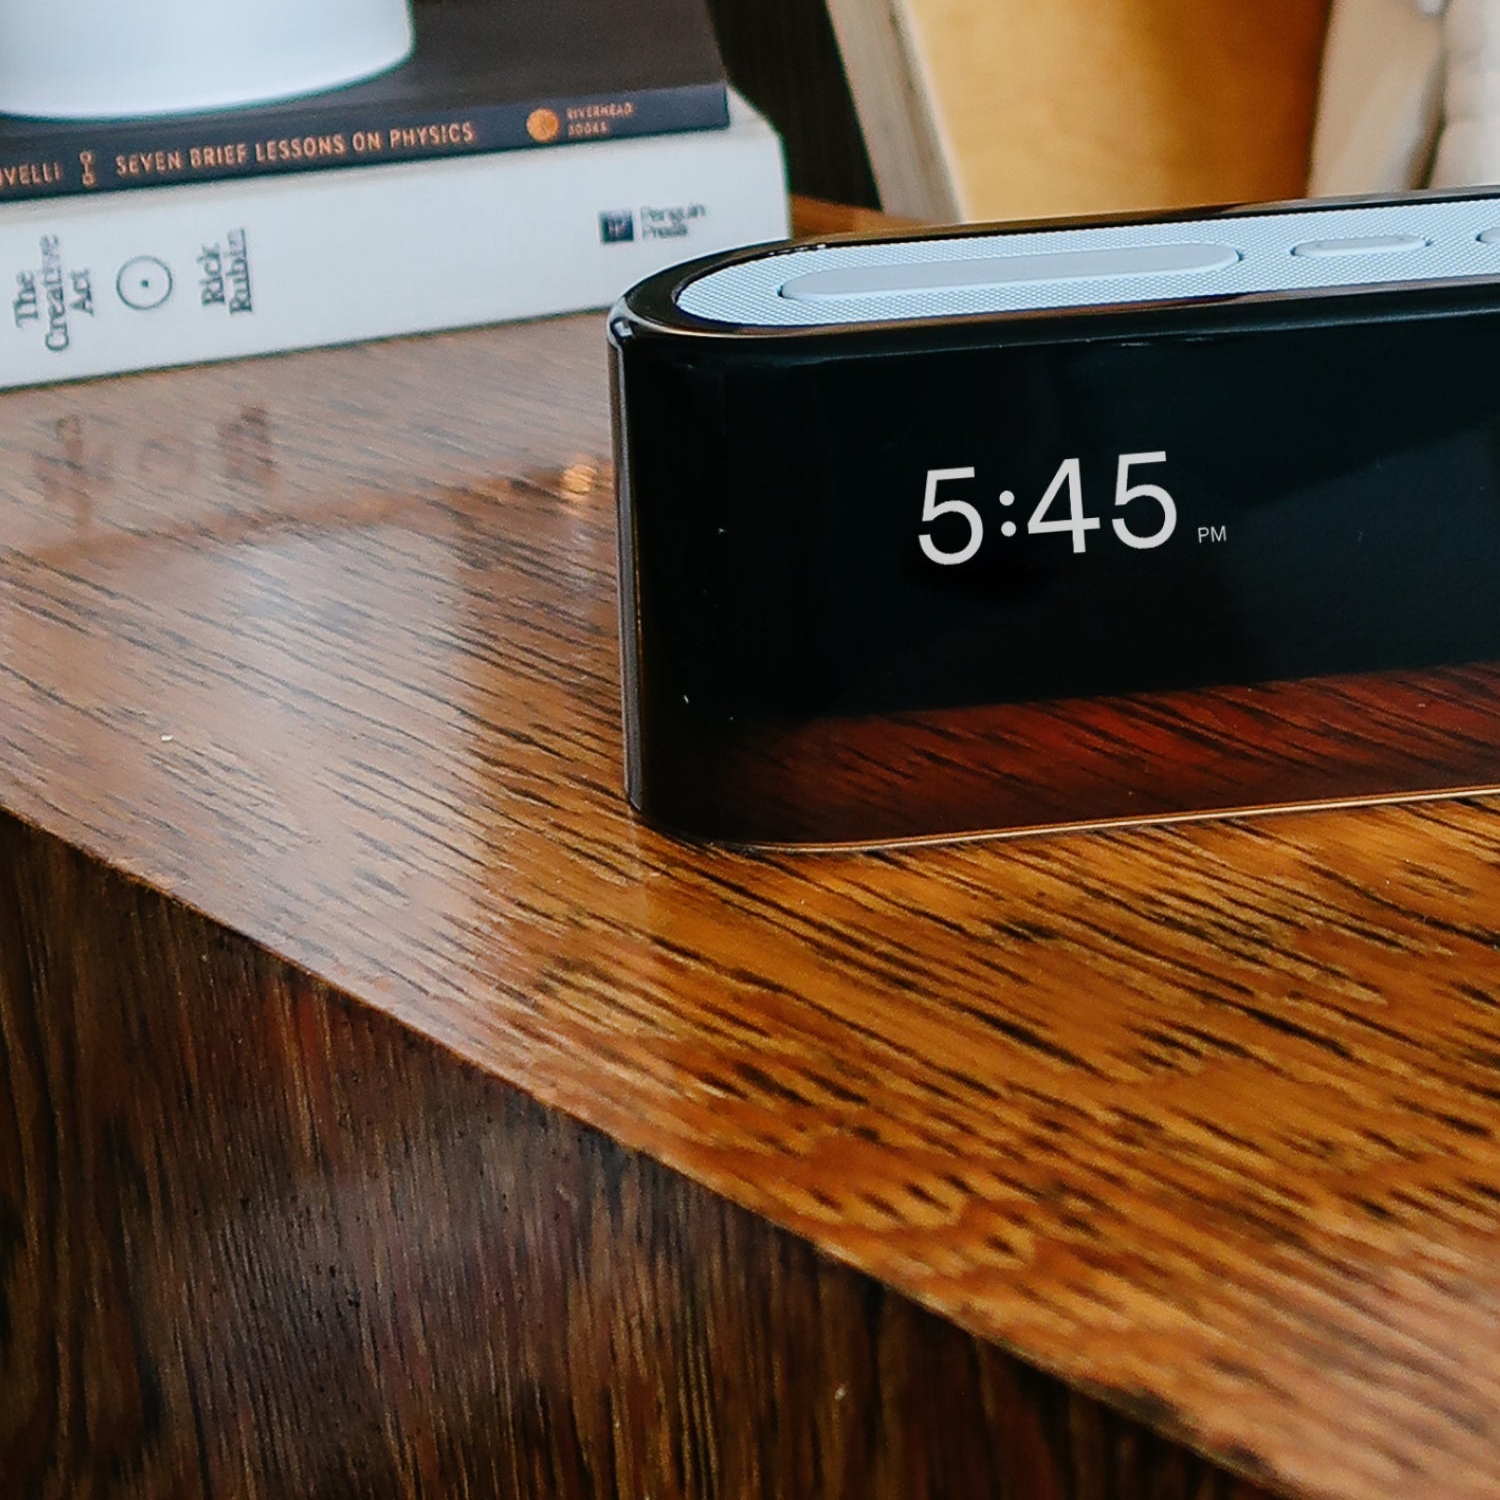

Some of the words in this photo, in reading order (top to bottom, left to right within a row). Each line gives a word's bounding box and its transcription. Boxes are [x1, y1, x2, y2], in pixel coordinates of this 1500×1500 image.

[0, 162, 63, 189] VELLI
[115, 150, 182, 176] SEVEN
[190, 142, 249, 167] BRIEF
[254, 132, 346, 162] LESSONS
[352, 129, 382, 153] ON
[389, 121, 475, 150] PHYSICS
[12, 270, 39, 329] The
[40, 234, 70, 352] Creative
[69, 267, 95, 318] Act
[196, 241, 226, 307] Rick
[223, 226, 254, 315] Rubin
[918, 450, 1177, 565] 5:45
[1197, 525, 1228, 544] PM
